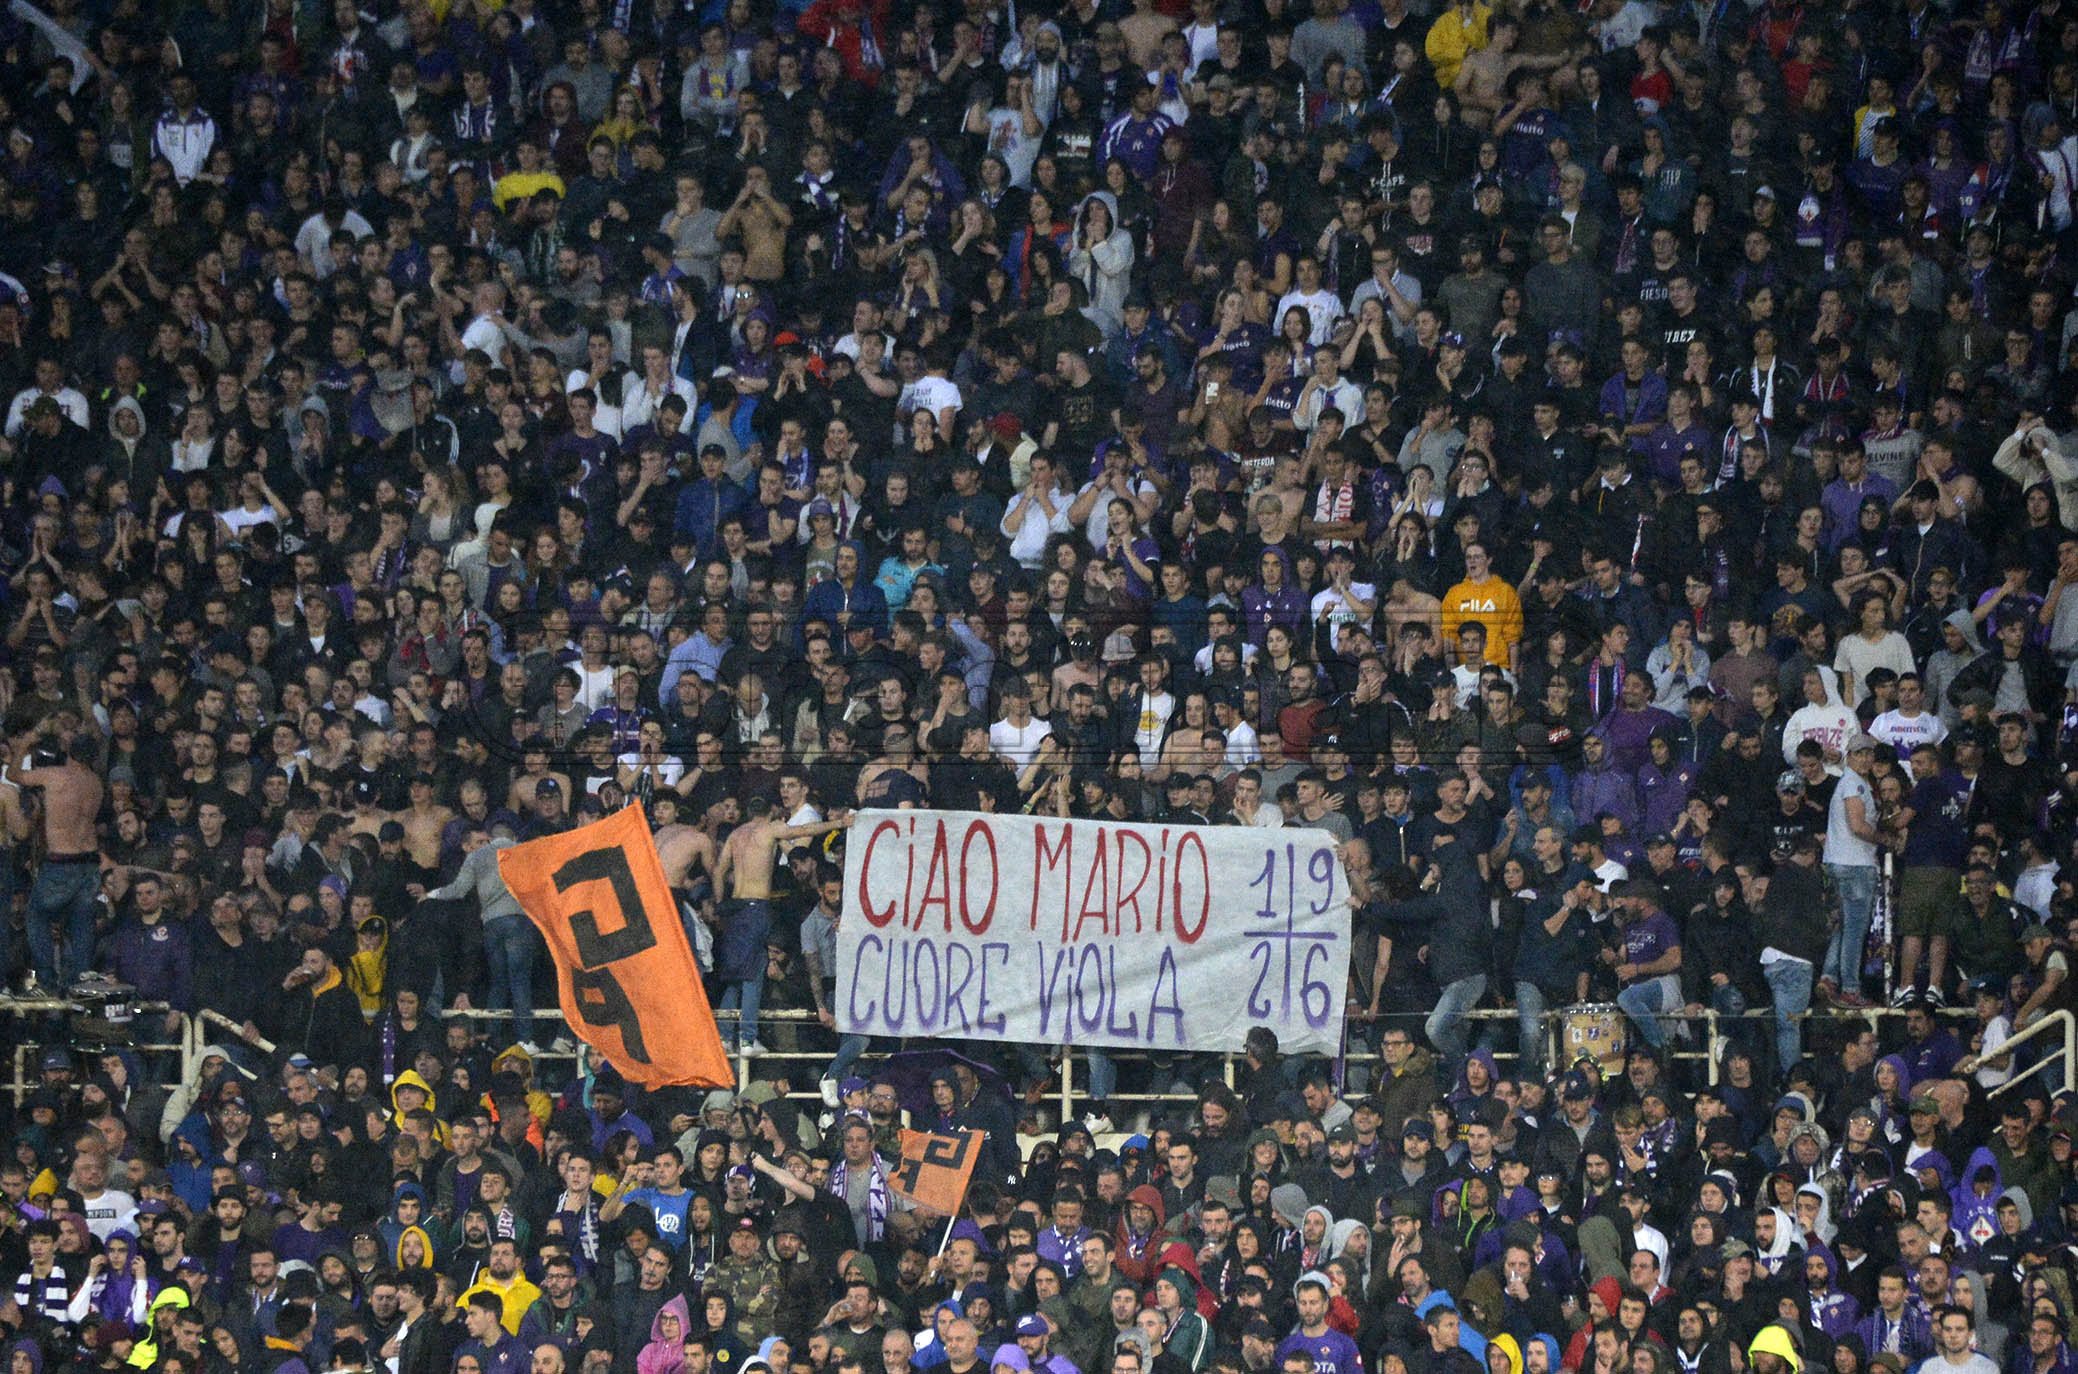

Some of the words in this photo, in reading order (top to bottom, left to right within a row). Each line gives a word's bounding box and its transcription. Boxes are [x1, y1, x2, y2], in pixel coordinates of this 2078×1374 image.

[1640, 287, 1668, 301] FIESO
[1459, 598, 1497, 612] FILA
[849, 934, 1009, 1034] CUORE
